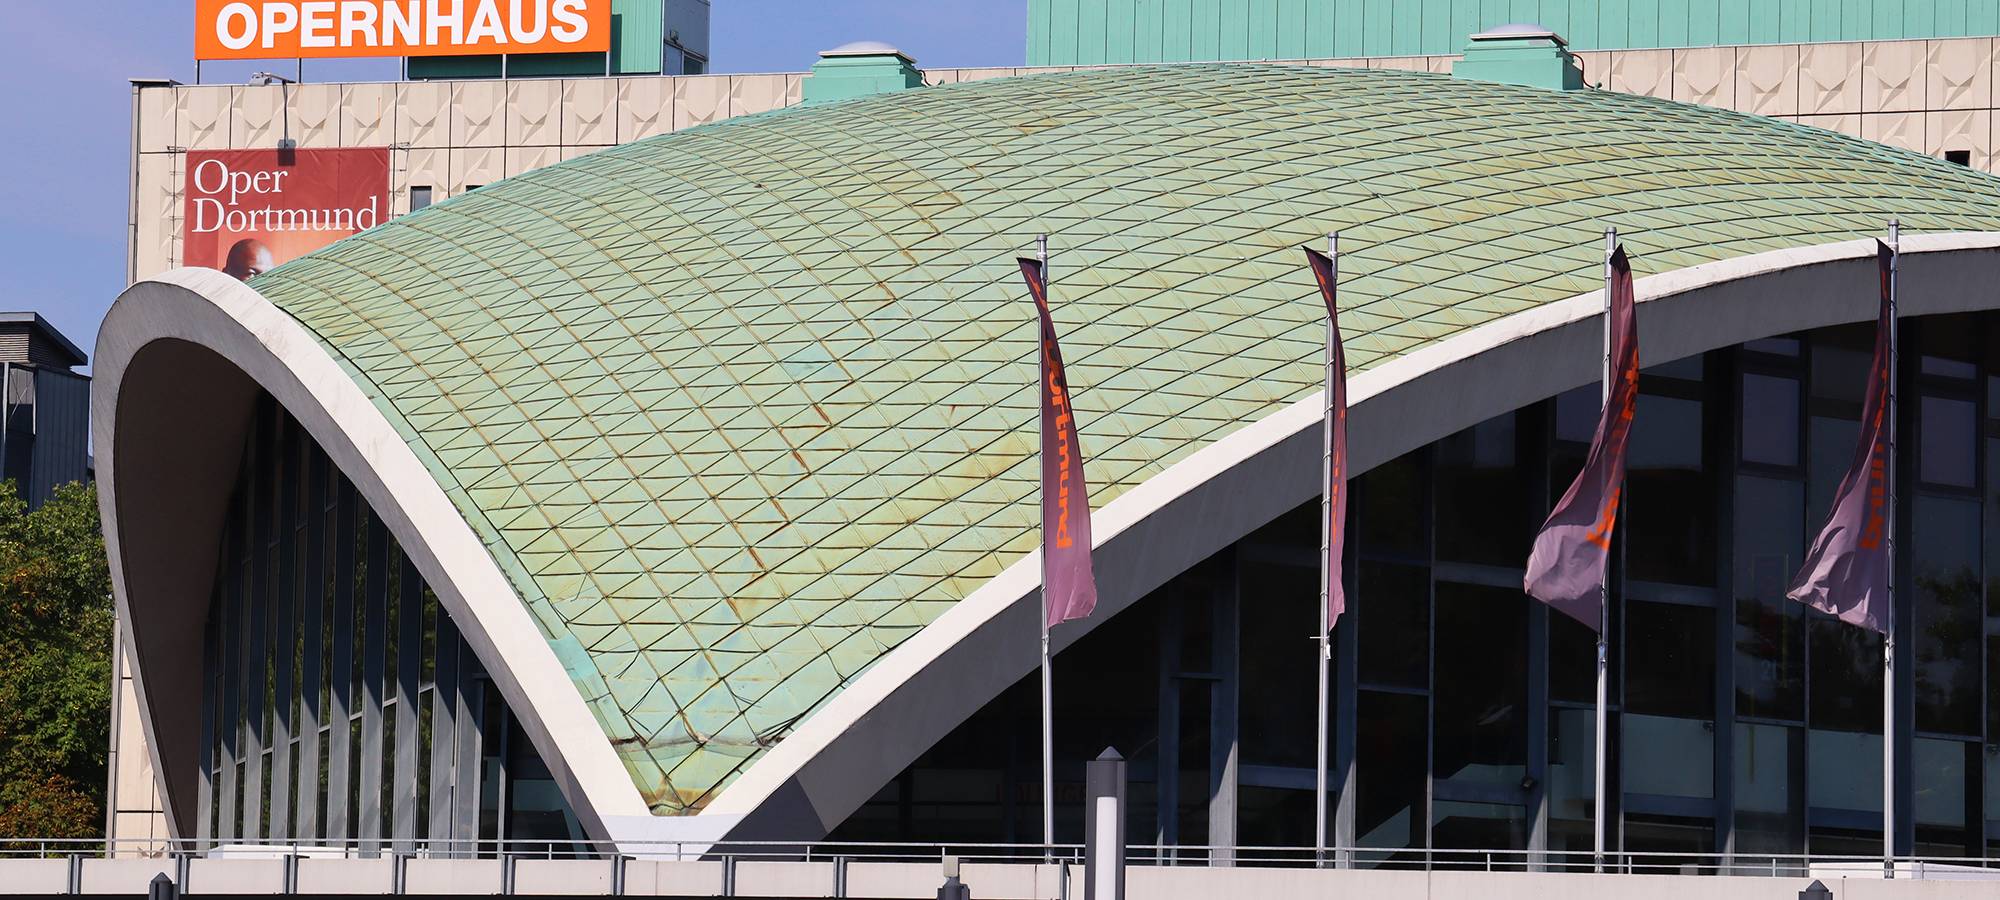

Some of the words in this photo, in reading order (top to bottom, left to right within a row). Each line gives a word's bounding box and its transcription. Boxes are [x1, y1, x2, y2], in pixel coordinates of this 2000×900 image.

[215, 0, 589, 49] OPERNHAUS
[194, 159, 288, 205] Oper
[191, 196, 377, 233] Dortmund
